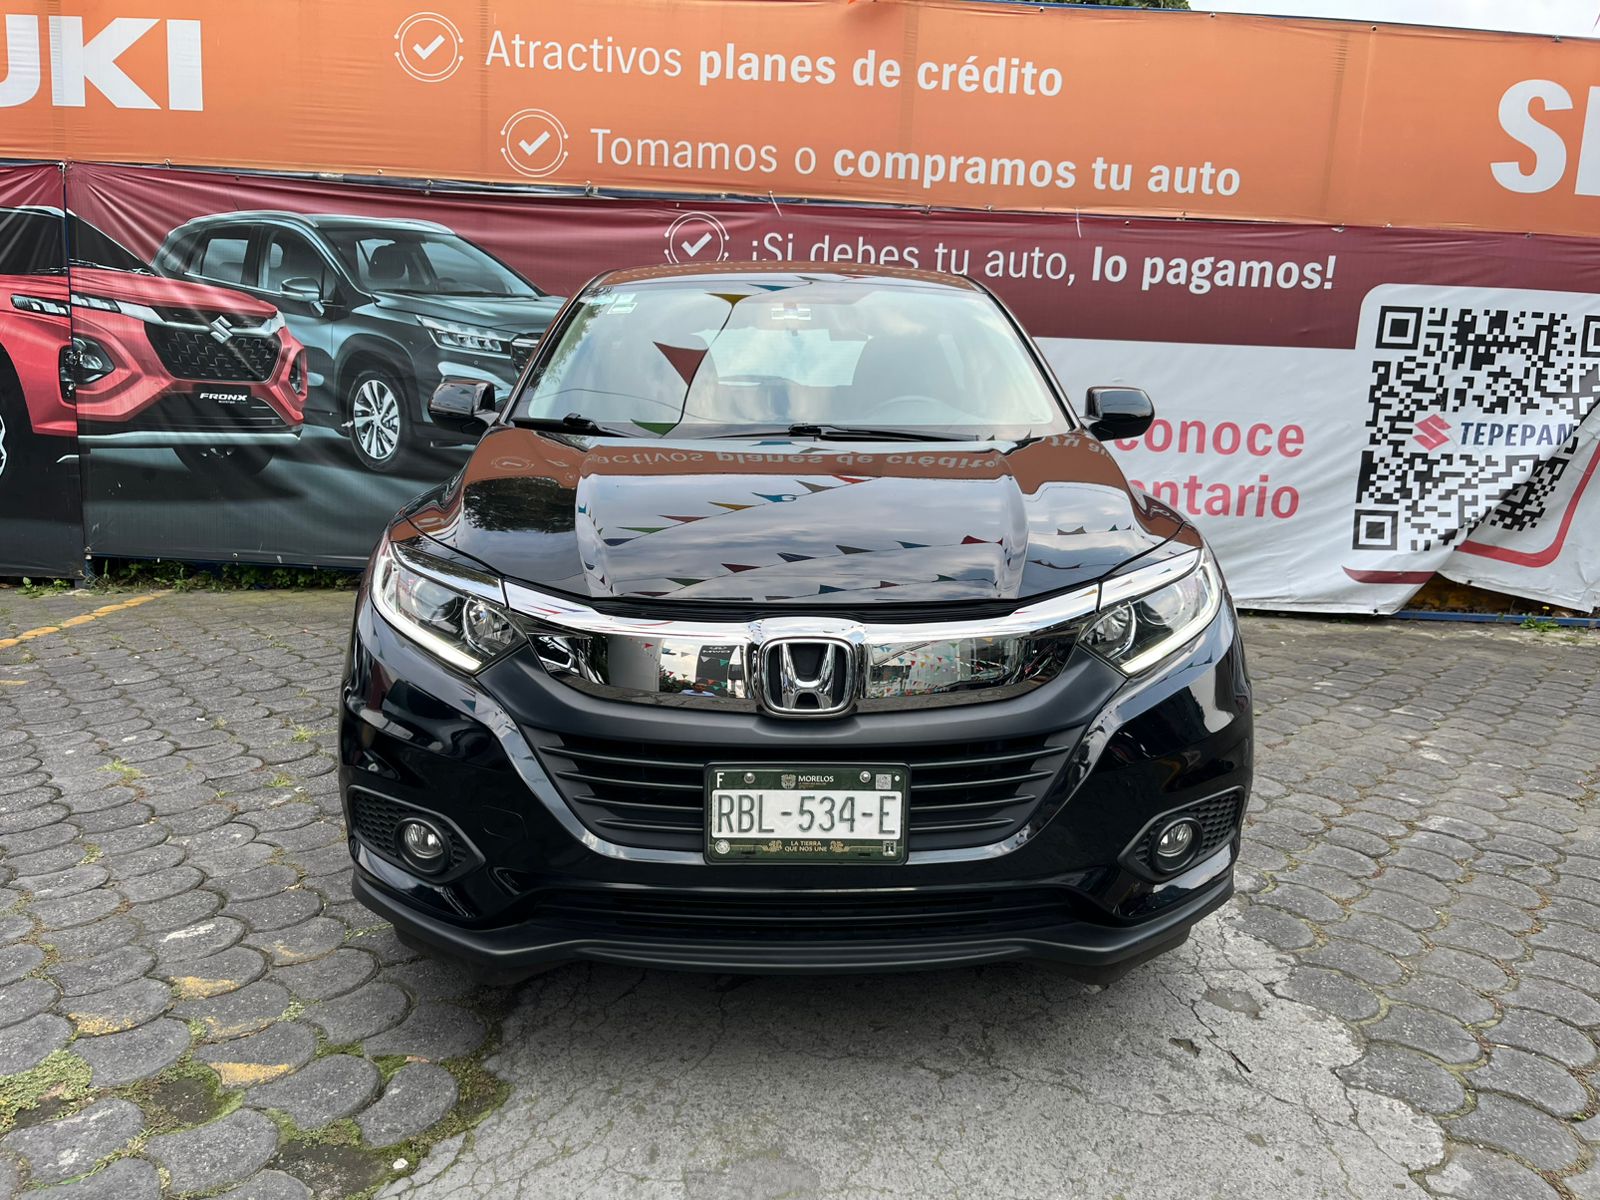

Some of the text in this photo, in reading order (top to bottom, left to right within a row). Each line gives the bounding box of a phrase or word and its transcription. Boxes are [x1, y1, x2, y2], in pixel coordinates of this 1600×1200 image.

[485, 30, 1063, 97] Atractivos planes de crédito
[590, 128, 1241, 196] Tomamos o compramos tu auto
[809, 234, 920, 269] debes
[934, 242, 970, 276] tu
[984, 246, 1076, 286] auto,
[1091, 246, 1128, 282] lo
[1141, 255, 1337, 294] pagamos!
[200, 392, 248, 401] FRONX
[1460, 422, 1574, 447] TEPEPAN
[1129, 474, 1300, 519] ntario
[798, 775, 834, 783] MORELOS
[717, 794, 897, 834] RBL-534-E
